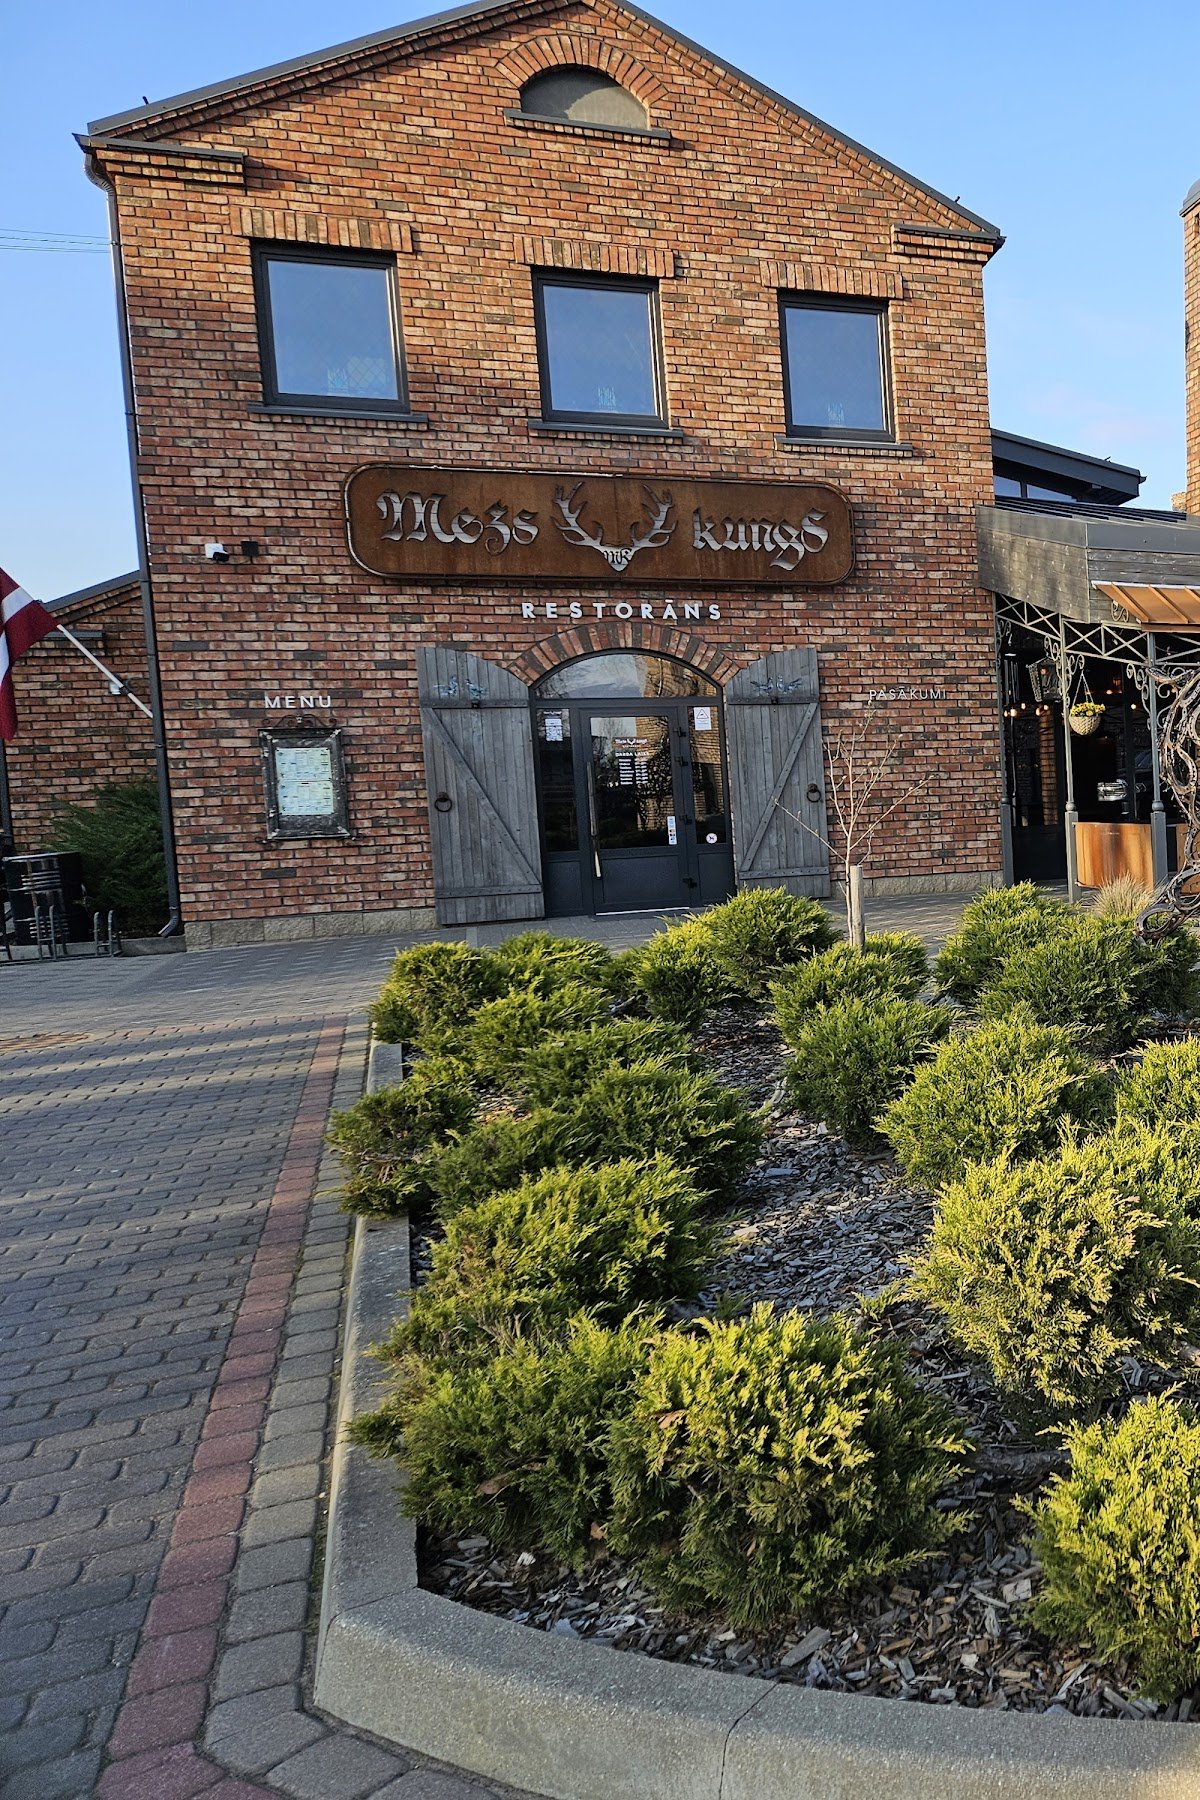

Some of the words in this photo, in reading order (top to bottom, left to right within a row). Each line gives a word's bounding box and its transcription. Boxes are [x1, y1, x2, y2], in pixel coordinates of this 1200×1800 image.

[521, 599, 721, 620] RESTORĀNS
[869, 686, 946, 700] PASĀKUMI
[264, 695, 331, 709] MENU
